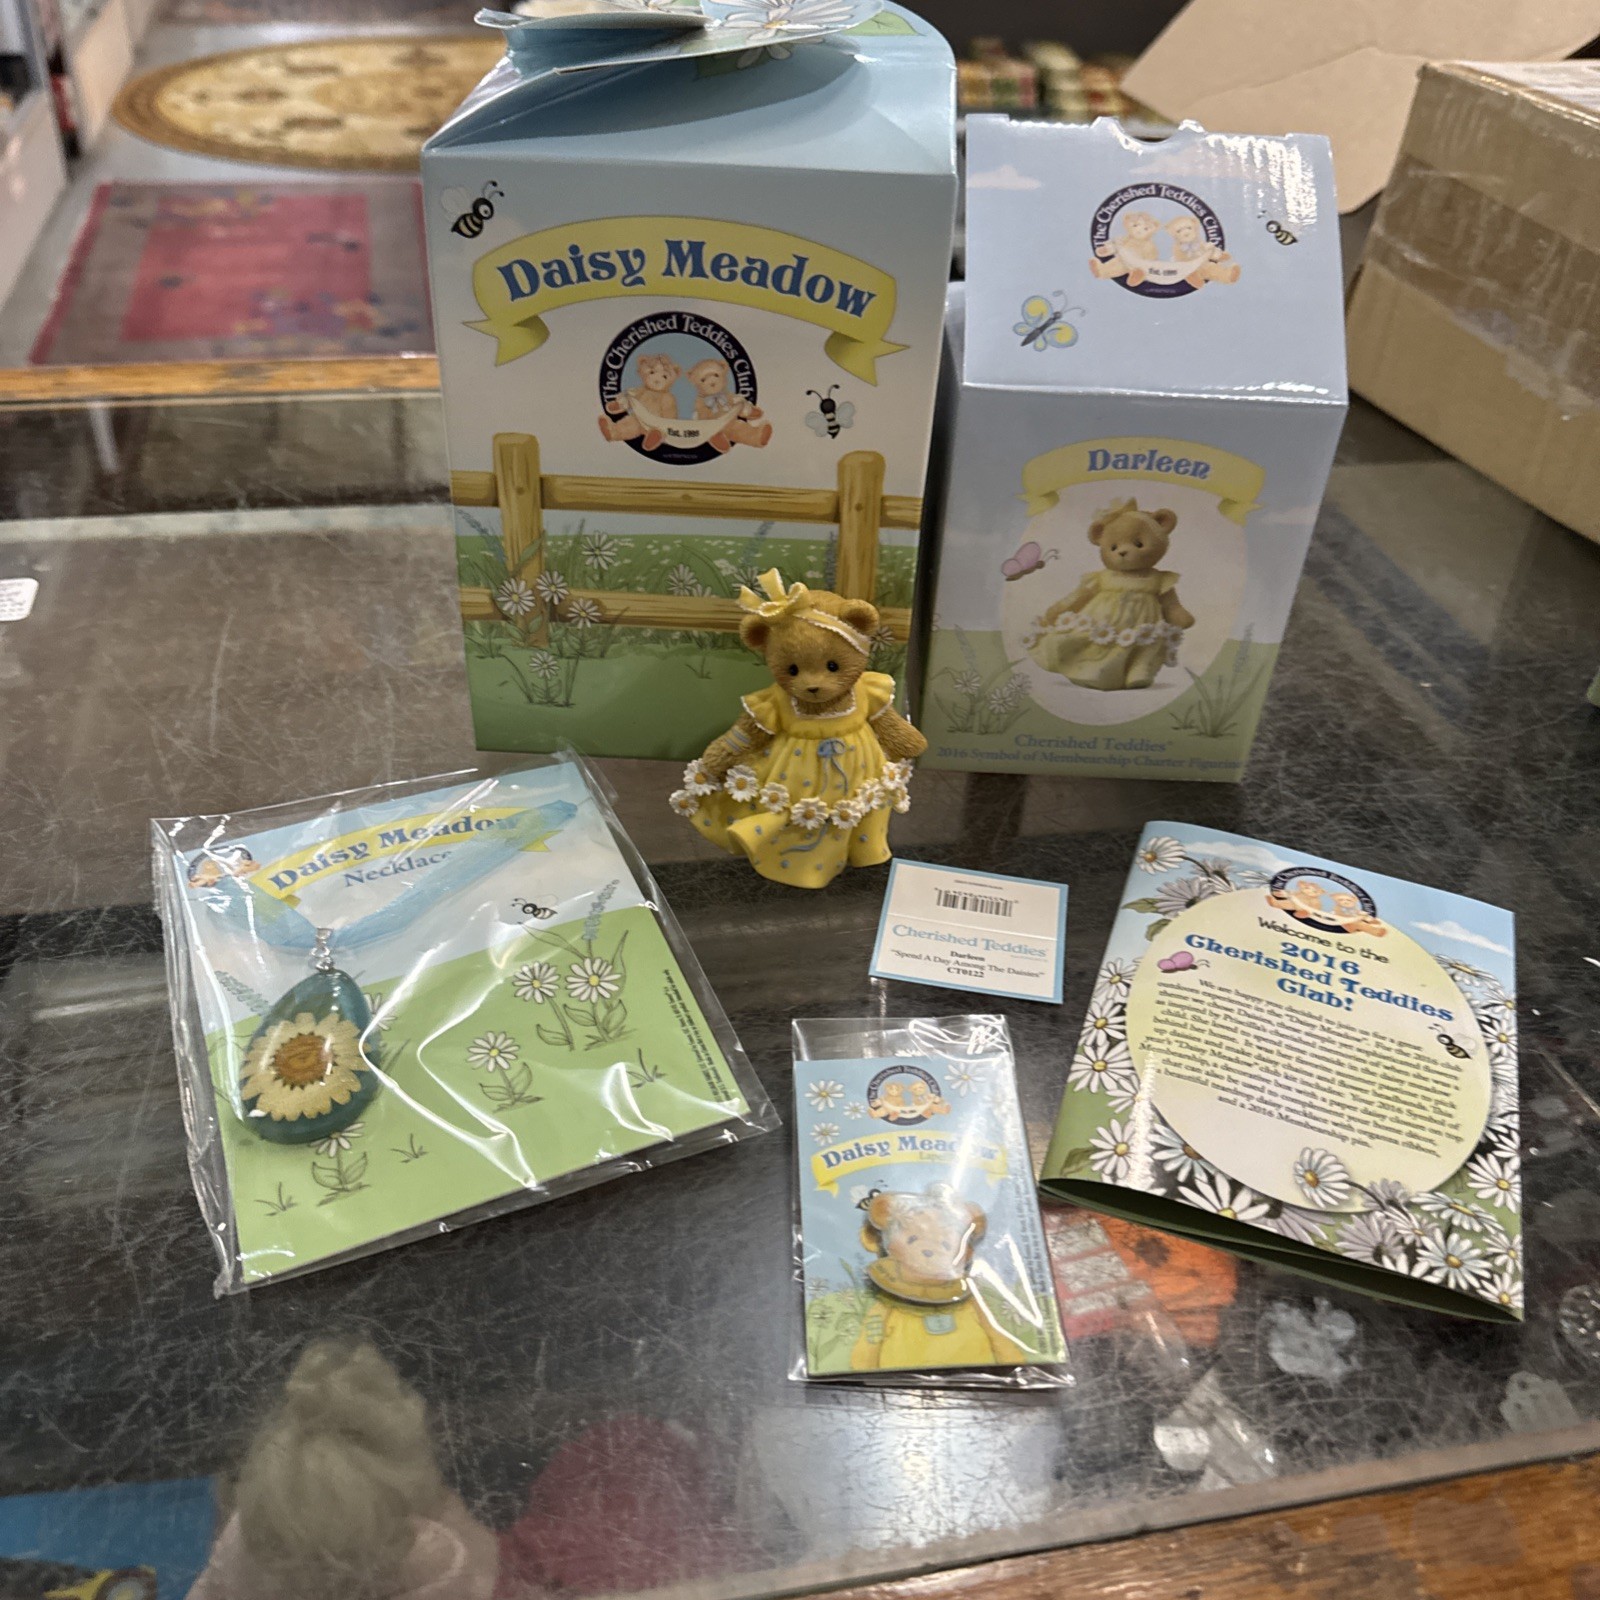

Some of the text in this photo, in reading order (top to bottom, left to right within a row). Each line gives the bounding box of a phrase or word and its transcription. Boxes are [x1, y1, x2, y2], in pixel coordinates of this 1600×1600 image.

[1095, 184, 1156, 224] Cherished
[1158, 184, 1206, 217] Teddies
[496, 239, 876, 319] Daisy Meadow
[602, 313, 755, 402] The Cherished Teddies Club
[1087, 449, 1211, 480] Darleen
[936, 746, 968, 758] 2016
[971, 748, 1019, 761] Symbol
[1023, 751, 1037, 761] of
[1133, 755, 1185, 767] Charter
[1014, 733, 1167, 752] Cherished Teddies
[267, 841, 369, 891] Daisy
[892, 924, 1047, 957] Cherished Teddies
[923, 953, 932, 962] A
[933, 955, 951, 968] Day
[952, 959, 985, 972] Among
[987, 962, 1006, 973] The
[950, 950, 985, 962] Darleen
[1257, 917, 1390, 964] Welcome to the
[1280, 941, 1360, 976] 2016
[947, 966, 985, 978] CT0122
[1184, 934, 1455, 1023] Cherished Teddies
[1276, 977, 1354, 1012] Club!
[1157, 982, 1200, 994] outdoors
[1201, 991, 1253, 1009] experience
[1254, 1005, 1265, 1013] in
[1266, 1008, 1283, 1018] the
[1375, 1041, 1392, 1052] For
[1394, 1048, 1411, 1057] the
[1414, 1053, 1439, 1065] 2016
[1440, 1061, 1463, 1072] club
[1159, 989, 1190, 1000] theme
[1191, 997, 1205, 1005] we
[1206, 1001, 1234, 1013] chose
[1276, 1021, 1302, 1033] these
[1304, 1031, 1336, 1044] simple
[1338, 1041, 1354, 1049] yet
[1356, 1047, 1421, 1070] sophisticated
[1422, 1065, 1459, 1080] flowers
[1199, 979, 1216, 989] We
[1234, 989, 1263, 1004] happy
[1265, 1000, 1283, 1009] you
[1285, 1005, 1322, 1021] decided
[1337, 1021, 1356, 1032] join
[1372, 1031, 1387, 1040] for
[1397, 1041, 1422, 1051] great
[1153, 1015, 1188, 1029] behind
[1190, 1023, 1207, 1033] her
[1244, 1039, 1254, 1047] It
[1255, 1044, 1275, 1055] was
[1276, 1049, 1294, 1060] her
[1295, 1056, 1334, 1073] favorite
[1335, 1070, 1377, 1086] summer
[1378, 1083, 1419, 1098] pastime
[1420, 1094, 1433, 1102] to
[1433, 1099, 1457, 1110] pick
[1168, 1000, 1207, 1014] inspired
[1208, 1010, 1221, 1019] by
[1269, 1029, 1317, 1049] cherished
[1318, 1045, 1368, 1064] memories
[1368, 1060, 1382, 1068] of
[1383, 1064, 1410, 1076] when
[1412, 1072, 1430, 1082] she
[1431, 1079, 1452, 1088] was
[1190, 1014, 1209, 1025] She
[1211, 1020, 1239, 1034] loved
[1253, 1034, 1283, 1048] spend
[1284, 1043, 1308, 1055] time
[1309, 1052, 1346, 1067] outside
[1360, 1066, 1378, 1077] the
[1379, 1072, 1406, 1086] daisy
[1407, 1081, 1451, 1097] meadow
[1153, 1027, 1168, 1036] up
[1169, 1029, 1202, 1043] daisies
[1204, 1039, 1223, 1049] and
[1224, 1045, 1253, 1058] make
[1253, 1053, 1280, 1068] daisy
[1282, 1059, 1314, 1077] chains
[1315, 1074, 1336, 1085] and
[1337, 1079, 1369, 1094] flower
[1431, 1104, 1453, 1119] This
[1161, 1058, 1183, 1069] that
[1184, 1064, 1203, 1074] can
[1204, 1069, 1225, 1080] also
[1241, 1081, 1266, 1094] used
[1267, 1089, 1279, 1098] to
[1280, 1094, 1345, 1119] complement
[1346, 1115, 1371, 1125] your
[1373, 1120, 1403, 1135] home
[1259, 1065, 1281, 1078] club
[1283, 1072, 1298, 1082] kit
[1350, 1092, 1375, 1106] Your
[1377, 1101, 1404, 1114] 2016
[1405, 1108, 1446, 1127] Symbol
[1447, 1122, 1461, 1130] of
[1163, 1067, 1209, 1086] beautiful
[1211, 1082, 1255, 1101] teardrop
[1256, 1095, 1283, 1110] daisy
[1284, 1106, 1329, 1124] necklace
[1331, 1120, 1355, 1132] with
[1357, 1128, 1400, 1145] organza
[1218, 1095, 1238, 1106] and
[1247, 1103, 1275, 1118] 2016
[1220, 1063, 1273, 1085] decorative
[1273, 1079, 1293, 1092] box
[1294, 1088, 1319, 1101] with
[1328, 1099, 1359, 1112] paper
[1360, 1106, 1388, 1121] daisy
[1388, 1115, 1427, 1131] closure
[1427, 1127, 1443, 1136] on
[1444, 1131, 1464, 1143] top
[821, 1142, 892, 1169] Daisy
